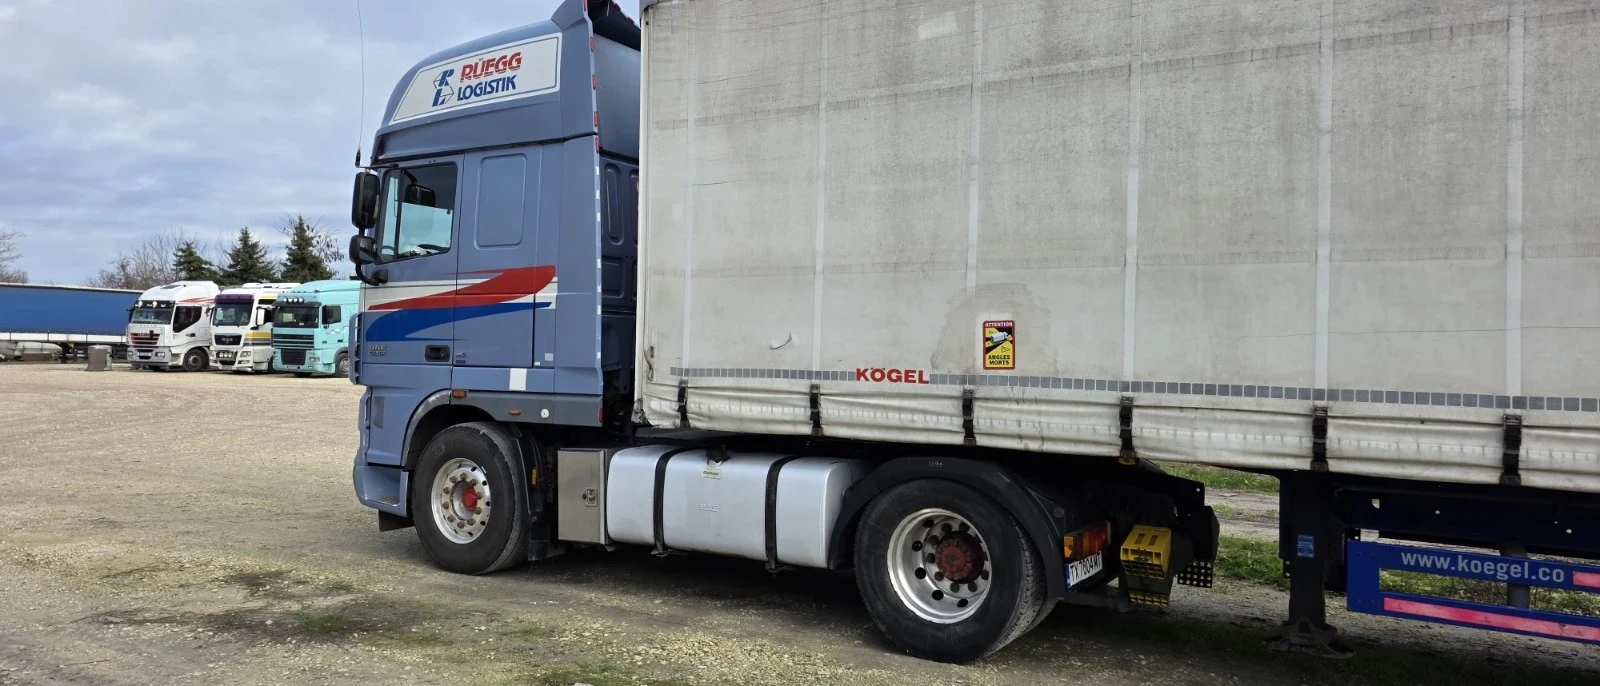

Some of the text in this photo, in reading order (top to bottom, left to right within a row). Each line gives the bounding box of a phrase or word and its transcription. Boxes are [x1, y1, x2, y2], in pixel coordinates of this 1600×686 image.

[460, 52, 522, 82] RÜEGG
[457, 75, 517, 101] LOGISTIK
[856, 368, 930, 385] KÖGEL
[1400, 552, 1564, 583] www.koegel.co
